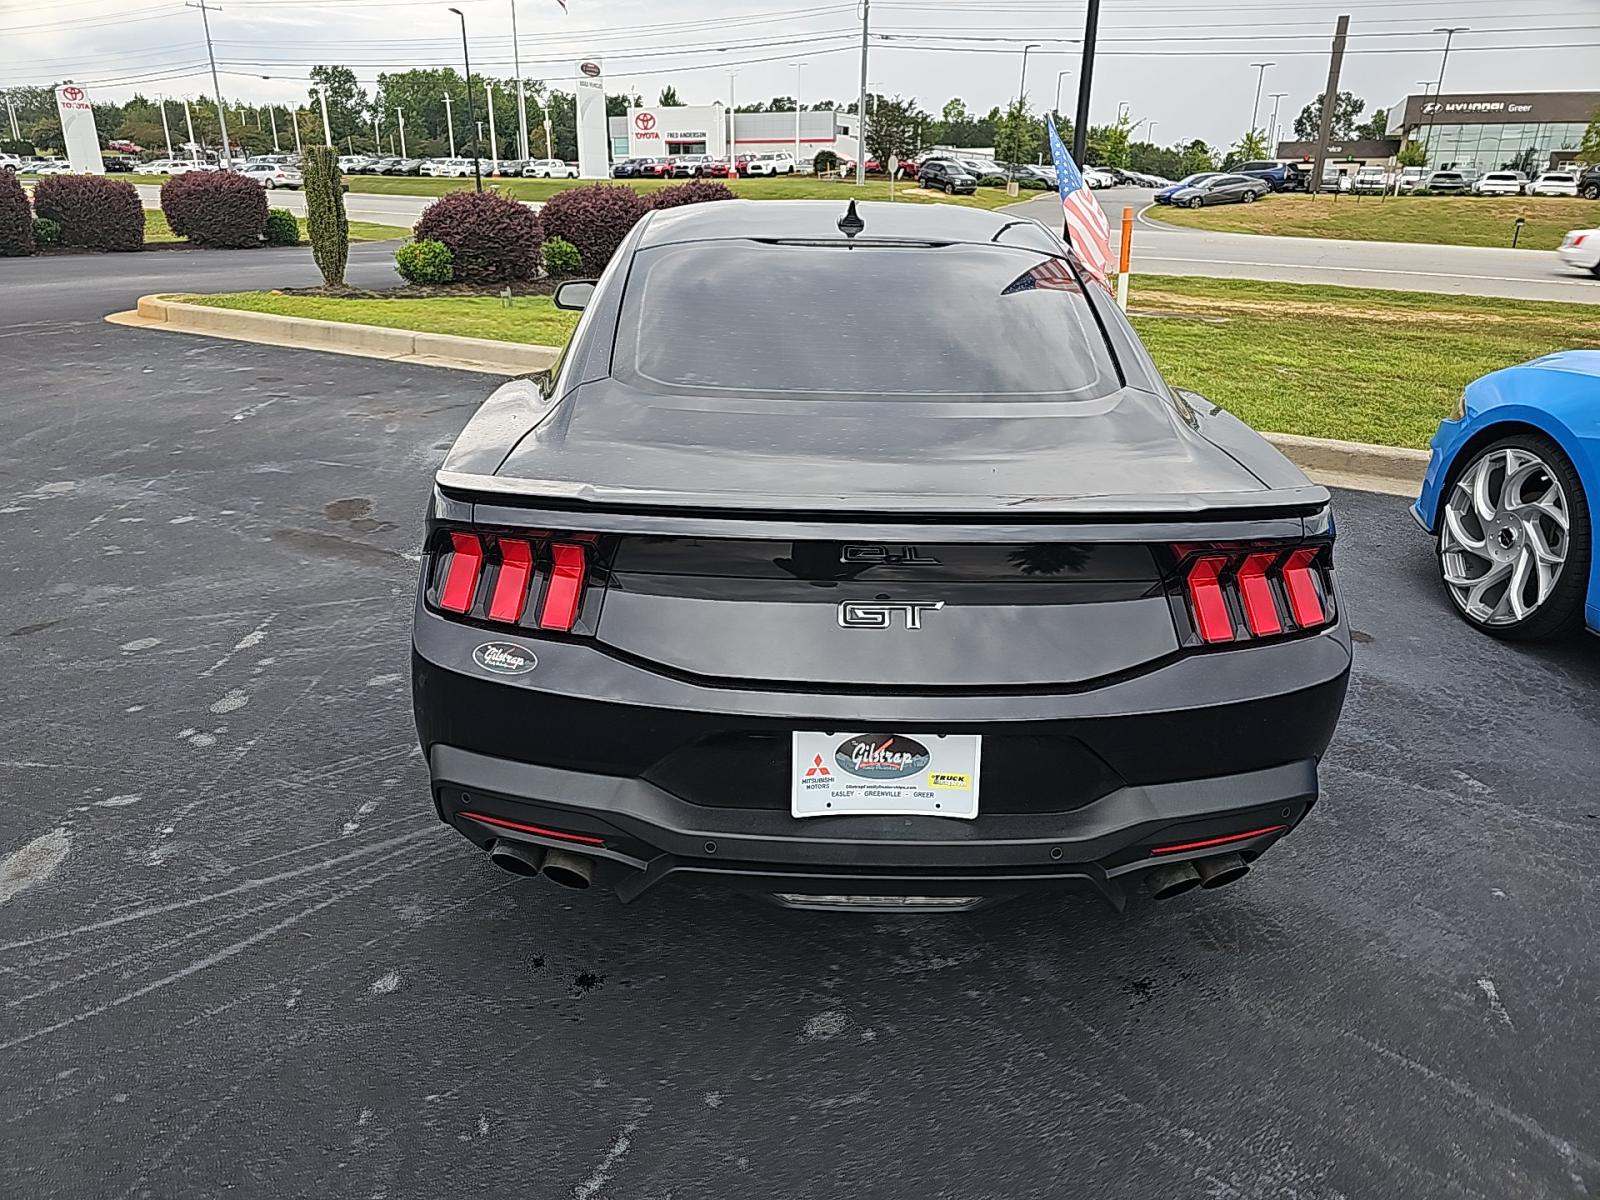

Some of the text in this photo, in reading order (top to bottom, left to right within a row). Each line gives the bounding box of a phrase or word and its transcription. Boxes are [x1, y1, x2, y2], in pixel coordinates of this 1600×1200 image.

[1508, 104, 1532, 113] Greer
[635, 132, 660, 140] TOYOTA
[838, 600, 945, 629] GT
[852, 741, 913, 771] Gilstrap
[935, 774, 965, 782] TRUCK
[864, 790, 901, 798] GREENVILLE
